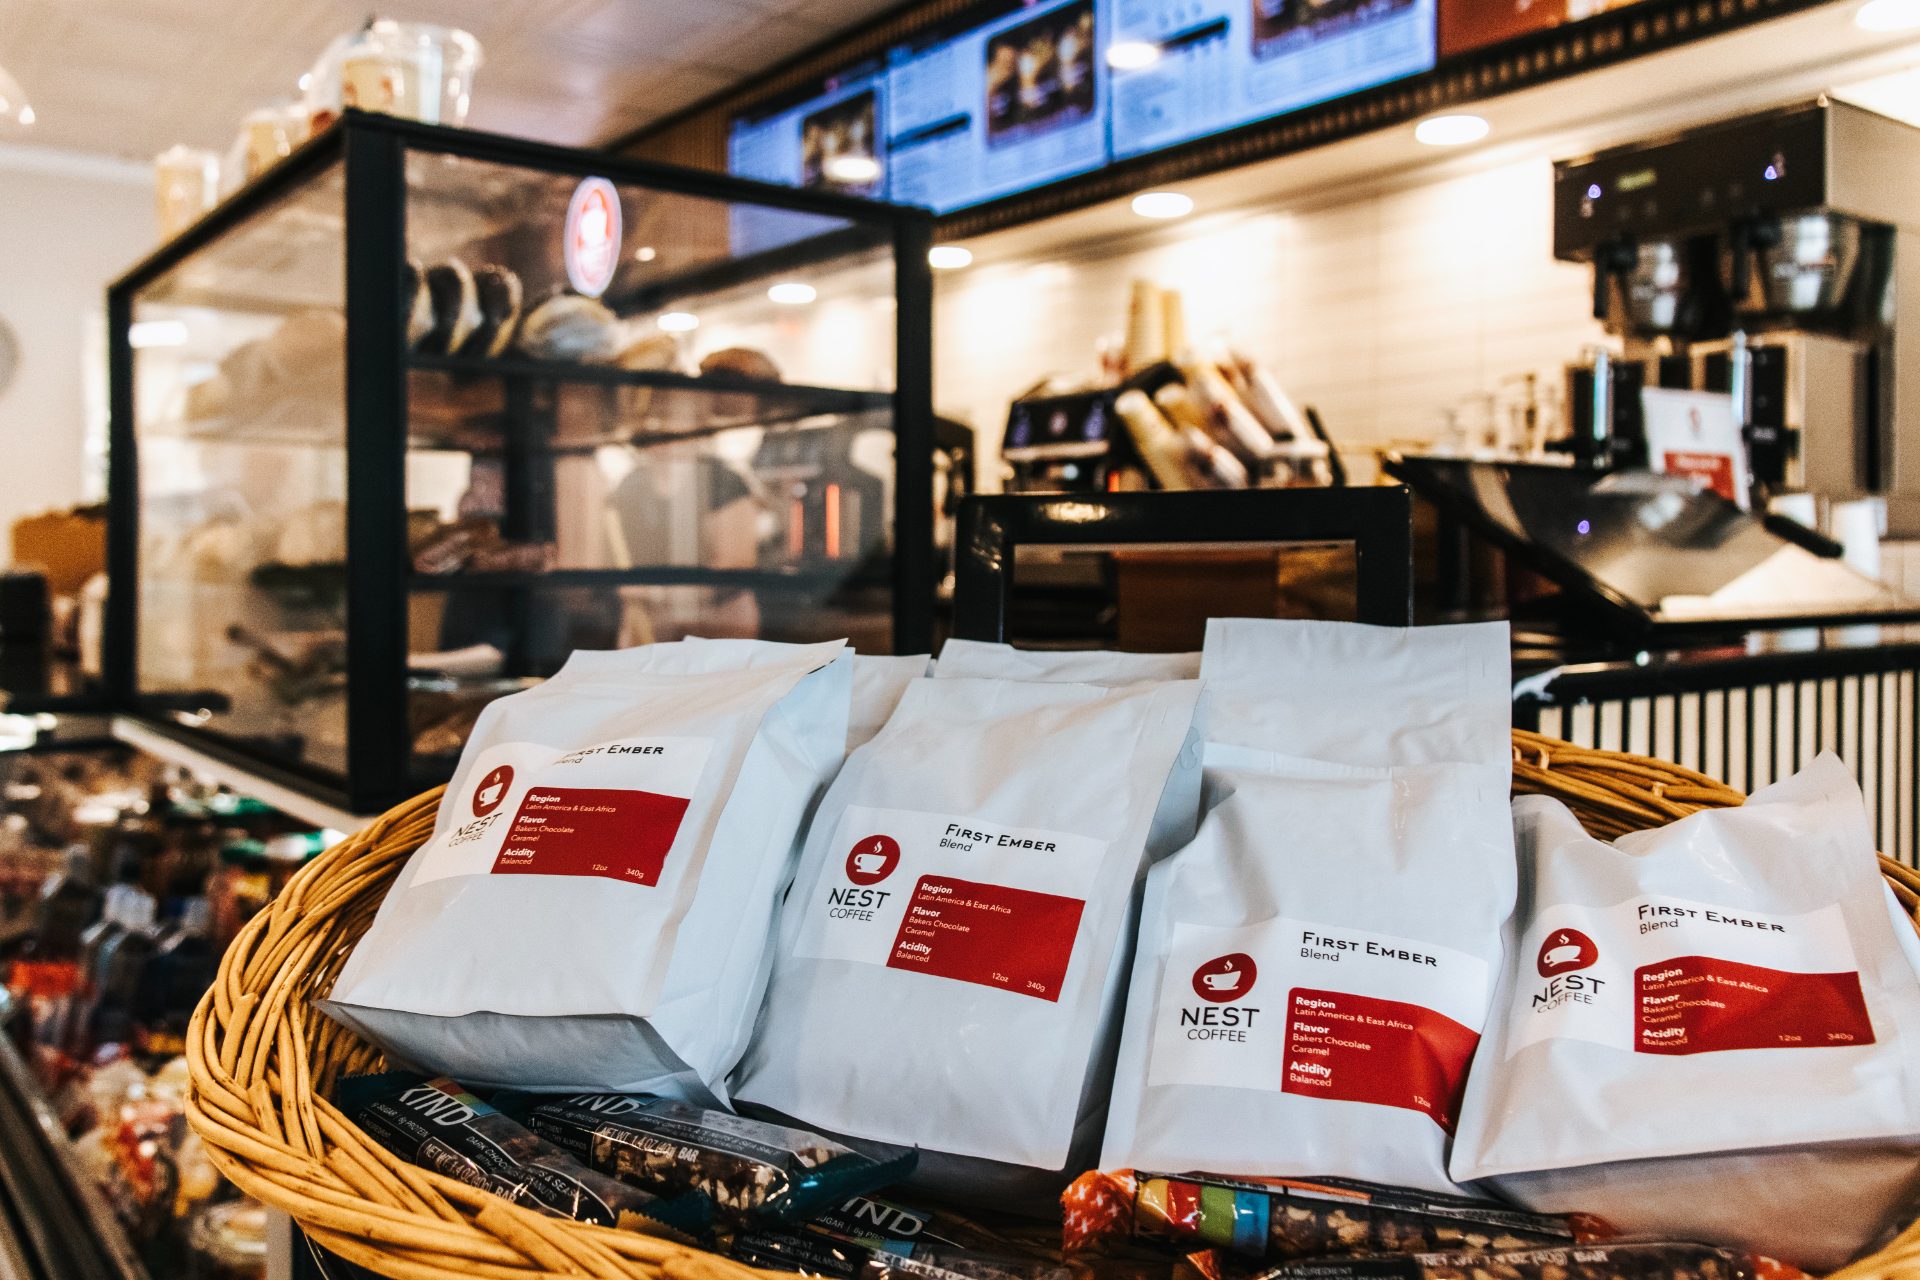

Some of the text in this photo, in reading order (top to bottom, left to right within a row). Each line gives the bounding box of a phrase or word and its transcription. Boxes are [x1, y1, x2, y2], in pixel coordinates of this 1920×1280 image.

[607, 744, 664, 755] EMBER
[529, 795, 561, 804] Region
[546, 804, 572, 812] America
[580, 805, 594, 813] East
[451, 812, 503, 839] NEST
[519, 816, 547, 824] Flavor
[515, 825, 575, 834] Bakers Chocolate
[511, 834, 540, 843] Caramel
[939, 838, 973, 852] Blend
[945, 823, 1057, 853] FIRST EMBER
[500, 857, 533, 865] Balanced
[504, 848, 536, 859] Acidity
[592, 864, 645, 879] 12oz 340g
[921, 883, 953, 895] Region
[828, 888, 891, 909] NEST
[917, 893, 1012, 915] Latin America & East Africa
[829, 907, 875, 922] COFFEE
[912, 906, 941, 918] Flavor
[1638, 904, 1786, 933] FIRST EMBER
[905, 926, 935, 938] Caramel
[908, 916, 970, 933] Bakers Chocolate
[1640, 919, 1679, 935] Blend
[899, 940, 932, 955] Acidity
[1300, 948, 1340, 962] Blend
[1303, 931, 1438, 967] FIRST EMBER
[896, 950, 930, 963] Balanced
[992, 972, 1046, 993] 12oz 340g
[1642, 967, 1683, 983] Region
[1532, 974, 1606, 1008] NEST
[1642, 975, 1769, 993] Latin America & East Africa
[1295, 996, 1336, 1010] Region
[1537, 991, 1593, 1014] COFFEE
[1642, 993, 1680, 1005] Flavor
[1642, 999, 1726, 1014] Bakers Chocolate
[1180, 1006, 1260, 1028] NEST
[1295, 1008, 1414, 1031] Latin America & East Africa
[1642, 1012, 1682, 1024] Caramel
[1187, 1028, 1247, 1043] COFFEE
[1293, 1022, 1330, 1034] Flavor
[1642, 1026, 1686, 1039] Acidity
[1292, 1033, 1371, 1051] Bakers Chocolate
[1642, 1036, 1689, 1046] Balanced
[1292, 1045, 1330, 1056] Caramel
[1290, 1061, 1332, 1078] Acidity
[1290, 1073, 1332, 1087] Balanced
[398, 1085, 474, 1126] KIND
[568, 1094, 640, 1115] IND
[465, 1135, 489, 1153] DARK
[601, 1127, 619, 1138] NET
[678, 1147, 700, 1163] BAR
[423, 1143, 442, 1157] NET
[450, 1160, 463, 1175] 1.4
[459, 1167, 476, 1184] OZ
[494, 1186, 519, 1203] BAR
[840, 1196, 923, 1236] IND
